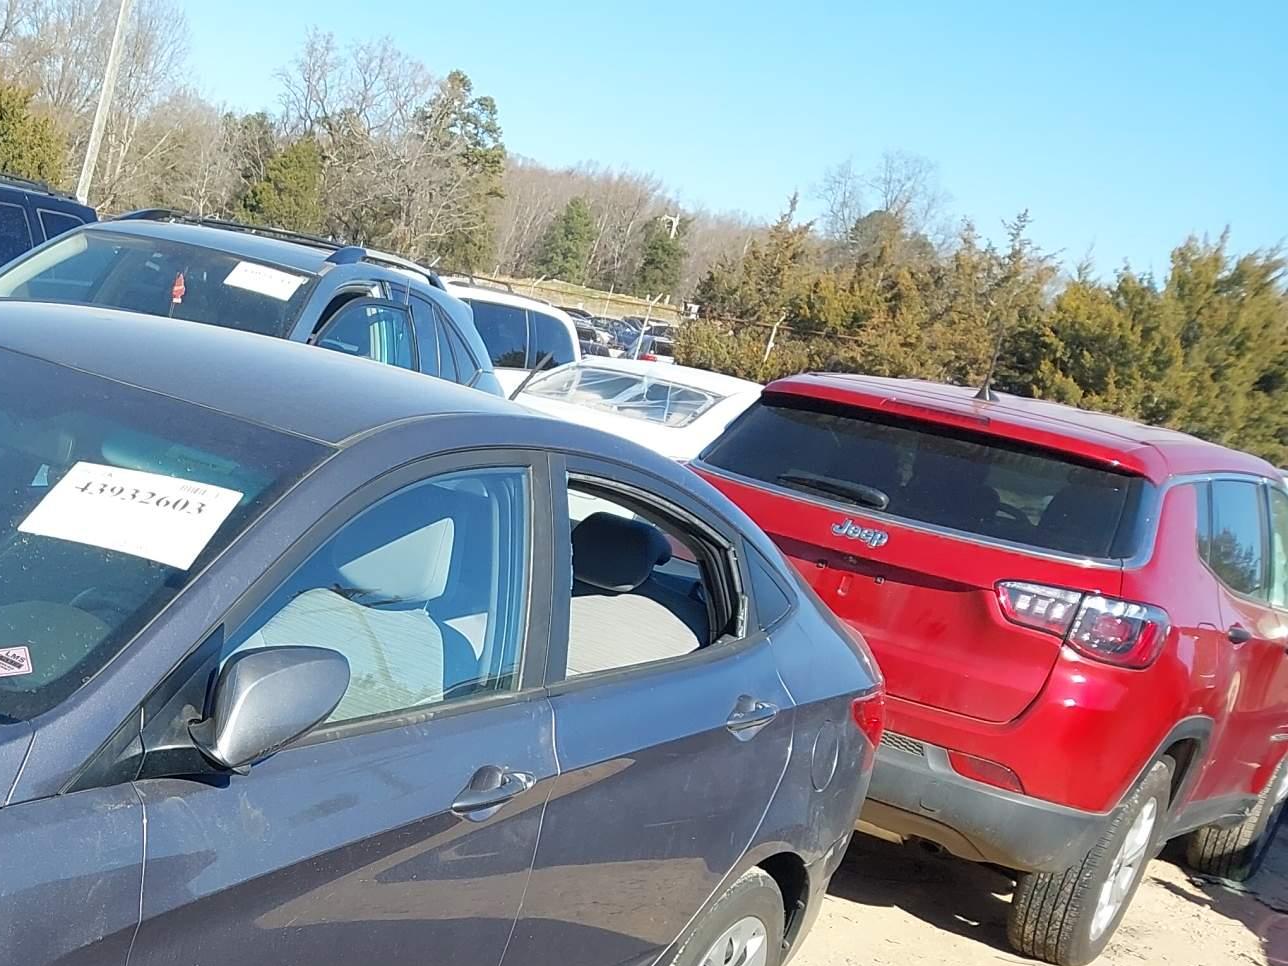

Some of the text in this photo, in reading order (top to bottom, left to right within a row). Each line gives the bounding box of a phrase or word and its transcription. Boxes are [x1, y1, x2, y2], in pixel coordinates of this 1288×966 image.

[74, 480, 207, 515] 43932603
[831, 517, 889, 548] Jeep
[5, 650, 26, 663] LMS
